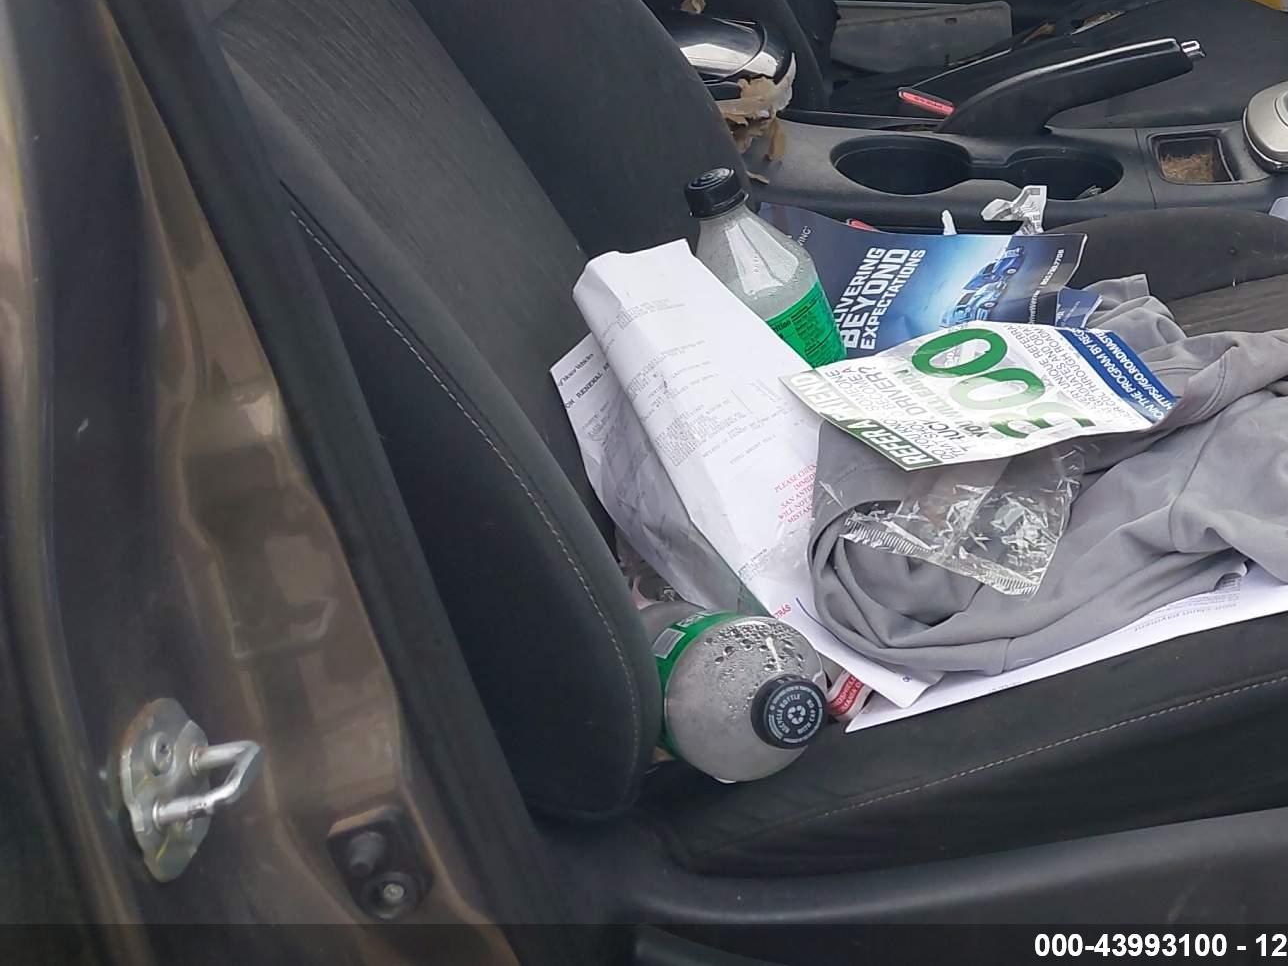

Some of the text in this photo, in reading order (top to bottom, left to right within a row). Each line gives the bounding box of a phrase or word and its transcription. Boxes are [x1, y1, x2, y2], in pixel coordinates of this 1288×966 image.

[840, 246, 910, 348] BEYOND
[859, 246, 926, 350] EXPECTATIONS
[1038, 345, 1059, 359] AND
[1086, 343, 1102, 354] BY
[575, 370, 603, 398] RENEWAL
[823, 368, 879, 413] SOMEONE
[856, 366, 928, 415] DRIVER?
[1038, 358, 1070, 389] UNIQUE
[1055, 362, 1105, 405] GRADUATES
[1059, 352, 1098, 392] THROUGH
[1097, 351, 1136, 392] PROGRAM
[789, 369, 854, 421] FRIEND
[847, 373, 896, 410] BECOME
[1131, 390, 1150, 406] THE
[860, 426, 931, 468] REFER
[906, 432, 933, 448] YOU
[773, 473, 798, 493] PLEASE
[780, 692, 800, 708] BOTTLE
